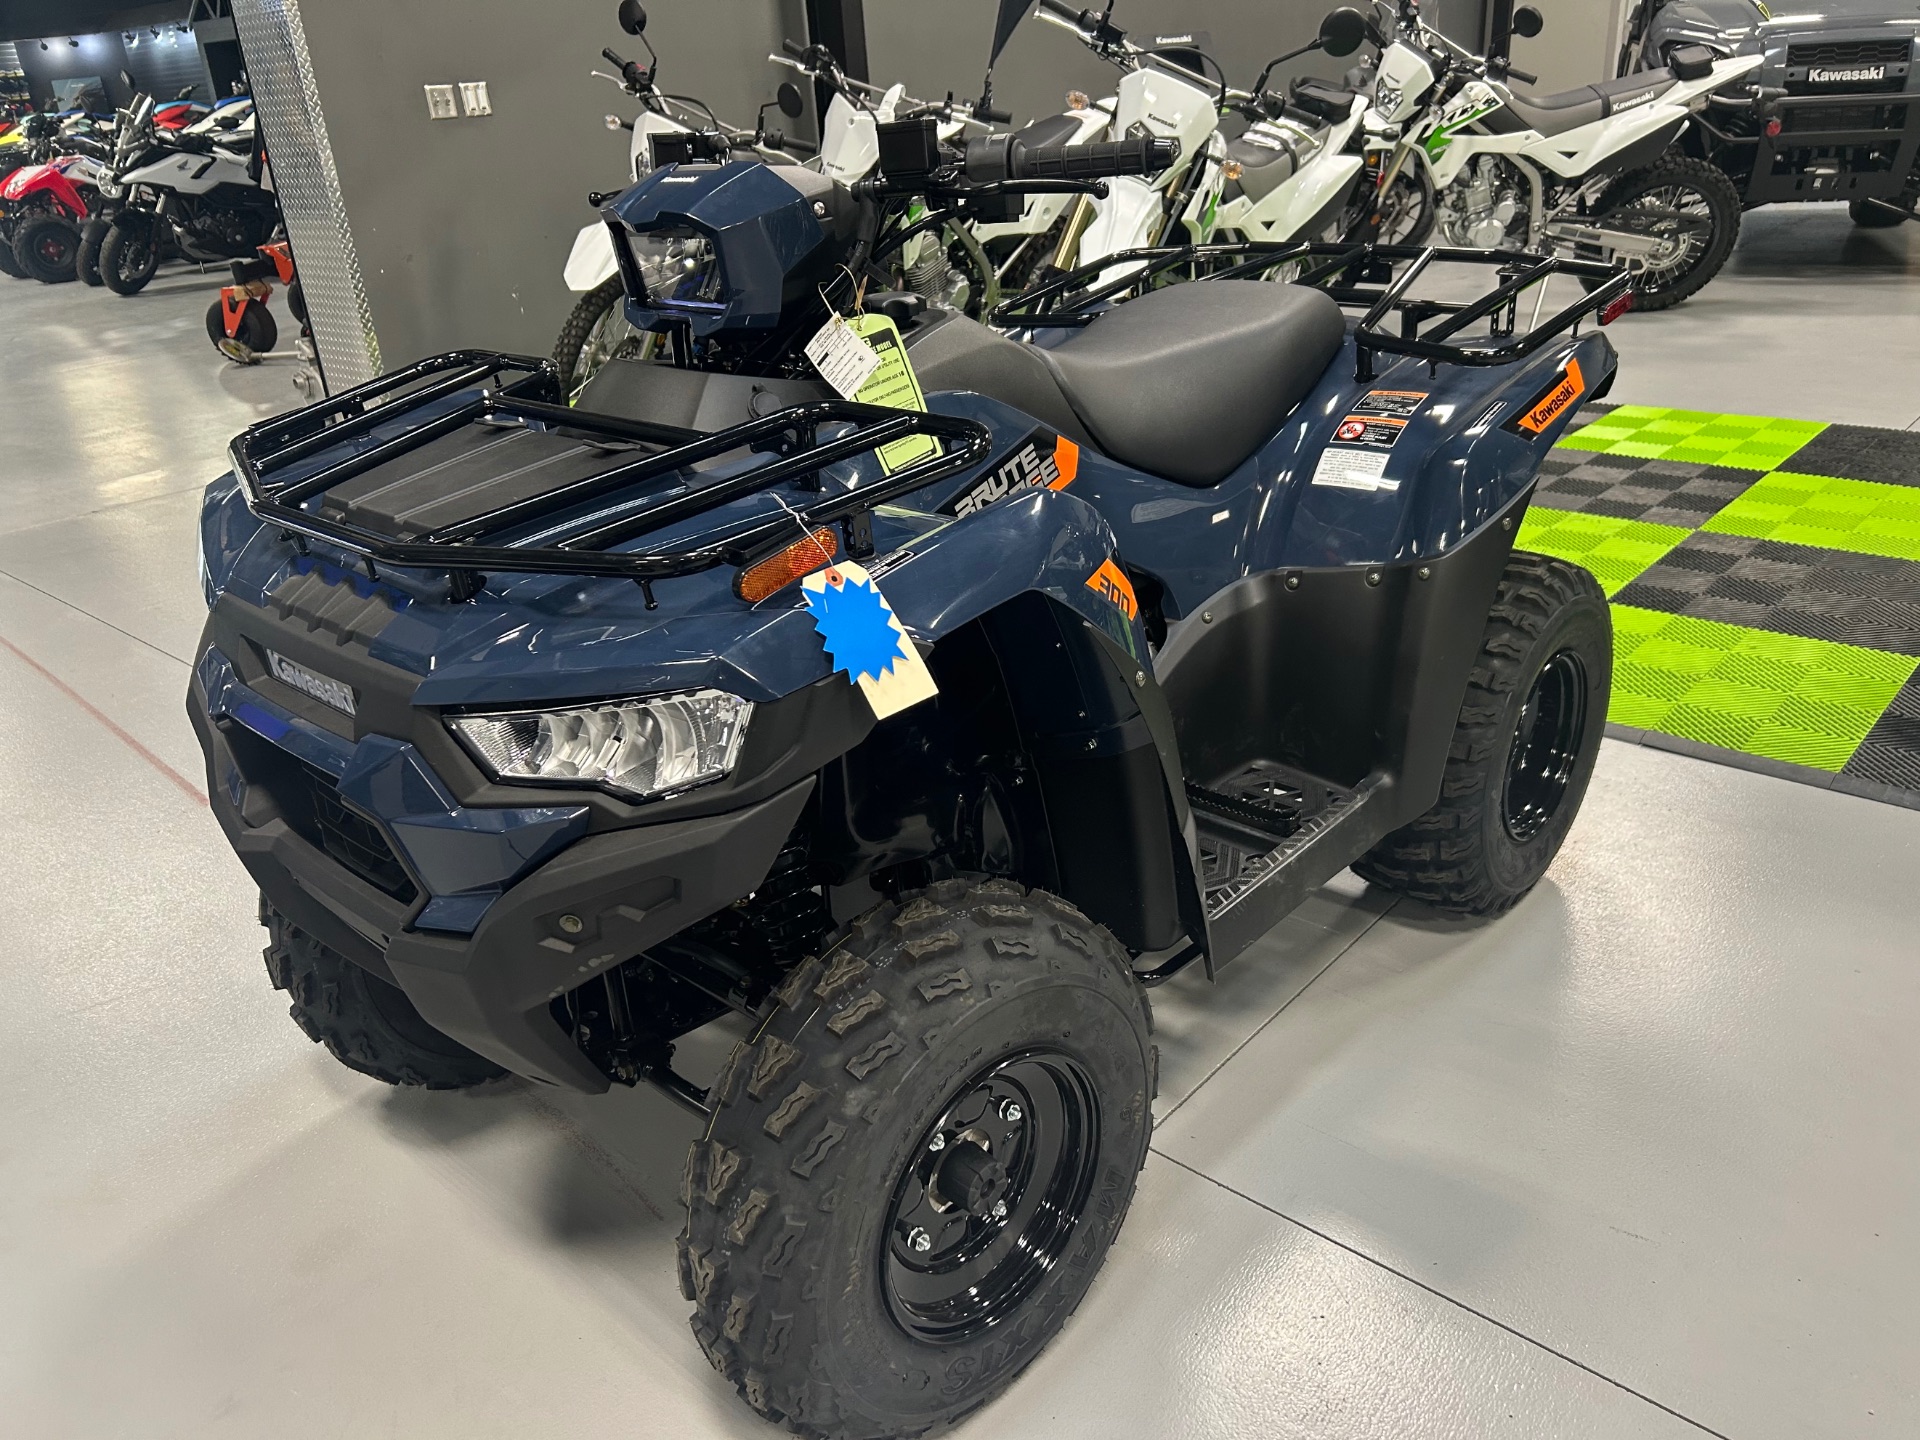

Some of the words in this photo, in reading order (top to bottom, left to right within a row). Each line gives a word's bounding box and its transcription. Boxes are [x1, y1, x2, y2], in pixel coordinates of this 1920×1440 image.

[1155, 34, 1192, 44] Kawasaki
[1808, 66, 1885, 82] Kawasaki
[1147, 112, 1177, 130] Kawasaki
[1612, 90, 1655, 112] Kawasaki
[1529, 380, 1576, 429] Kawasaki
[955, 443, 1040, 520] BRUTE
[1099, 571, 1131, 617] 300
[266, 648, 356, 716] Kawasaki
[940, 1166, 1127, 1396] MAXXIS
